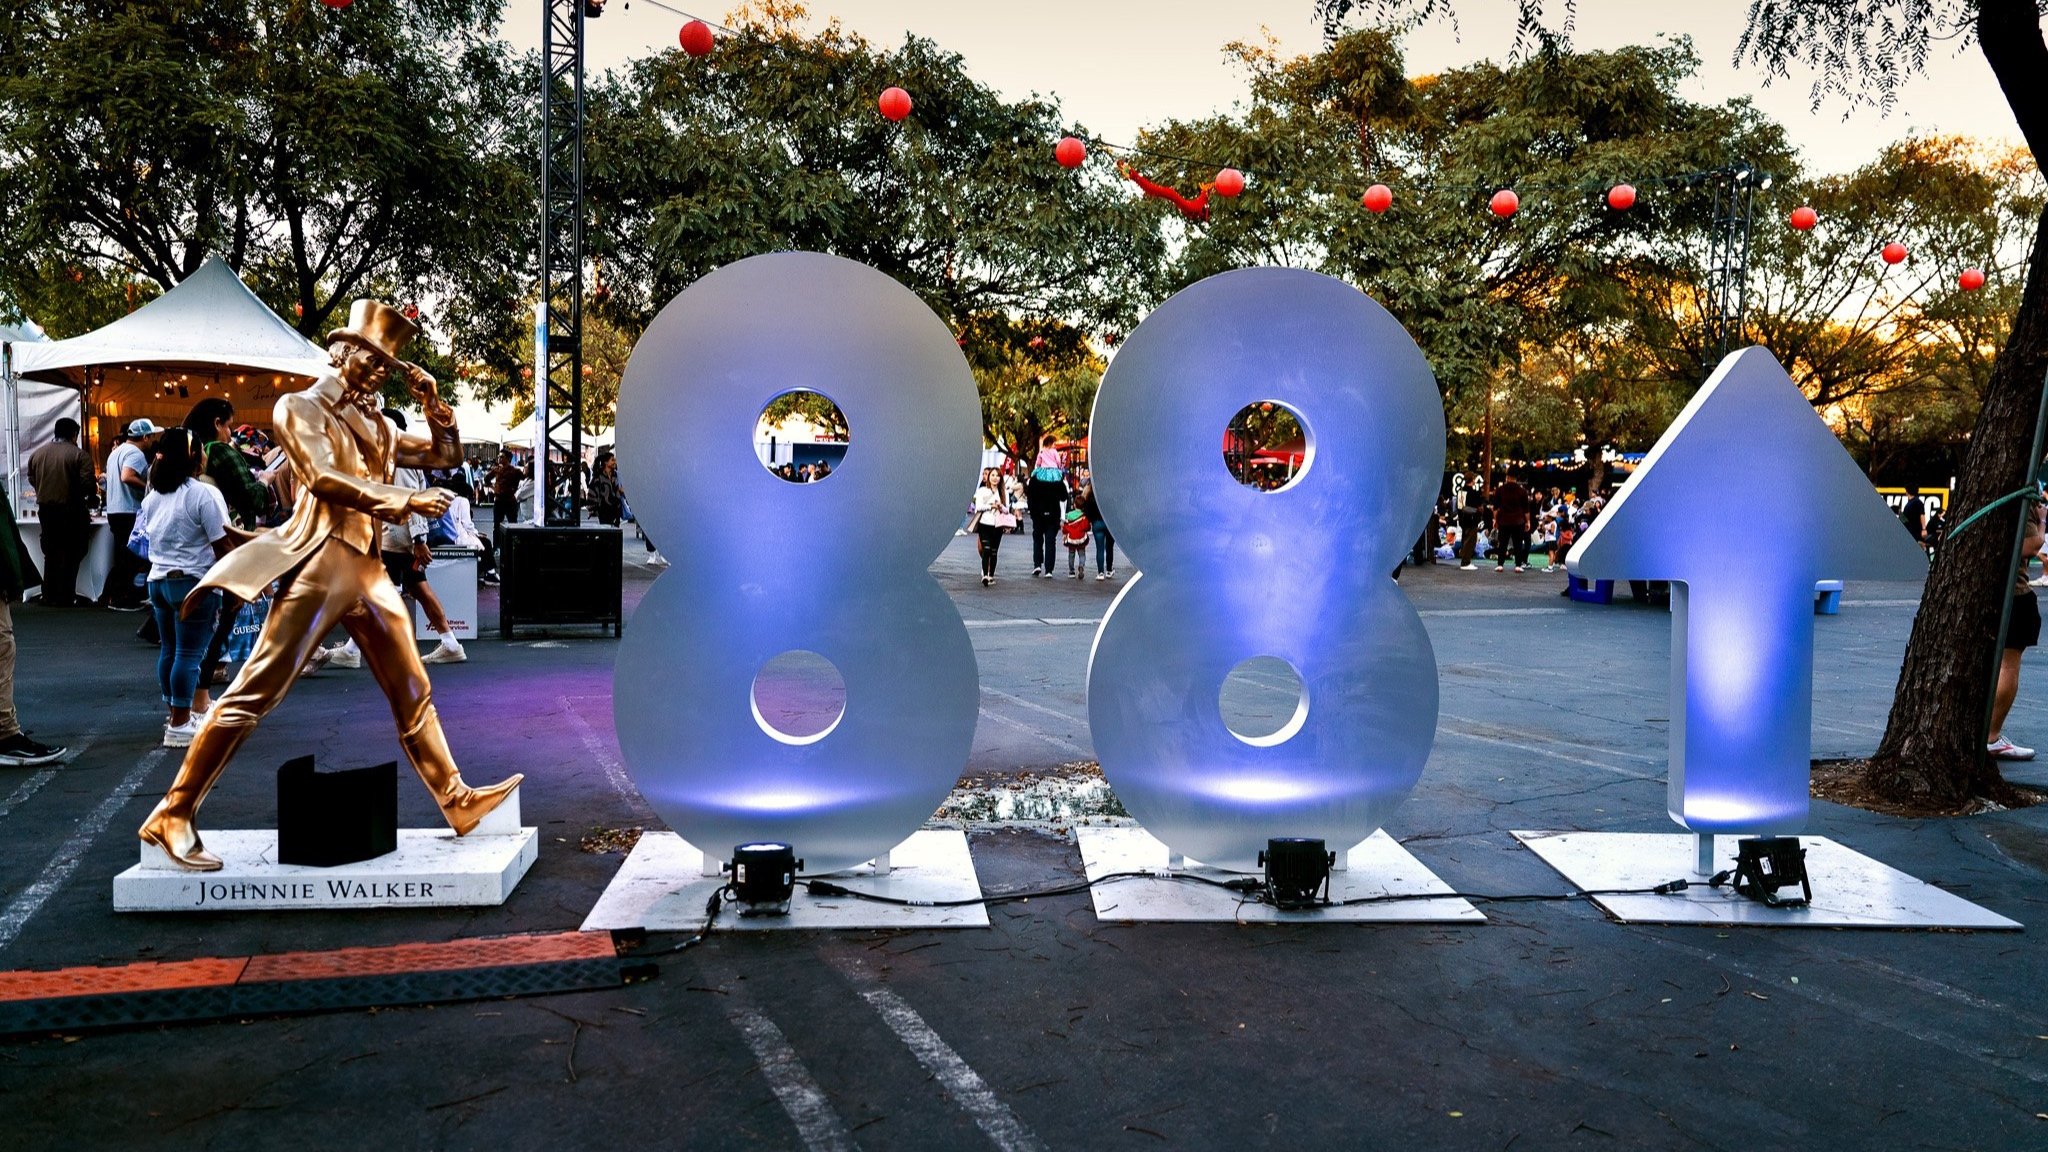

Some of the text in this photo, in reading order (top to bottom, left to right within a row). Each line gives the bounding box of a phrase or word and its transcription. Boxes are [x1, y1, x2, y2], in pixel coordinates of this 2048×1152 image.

[233, 624, 260, 635] GUESS
[195, 880, 434, 905] JOHNNIE WALKER
